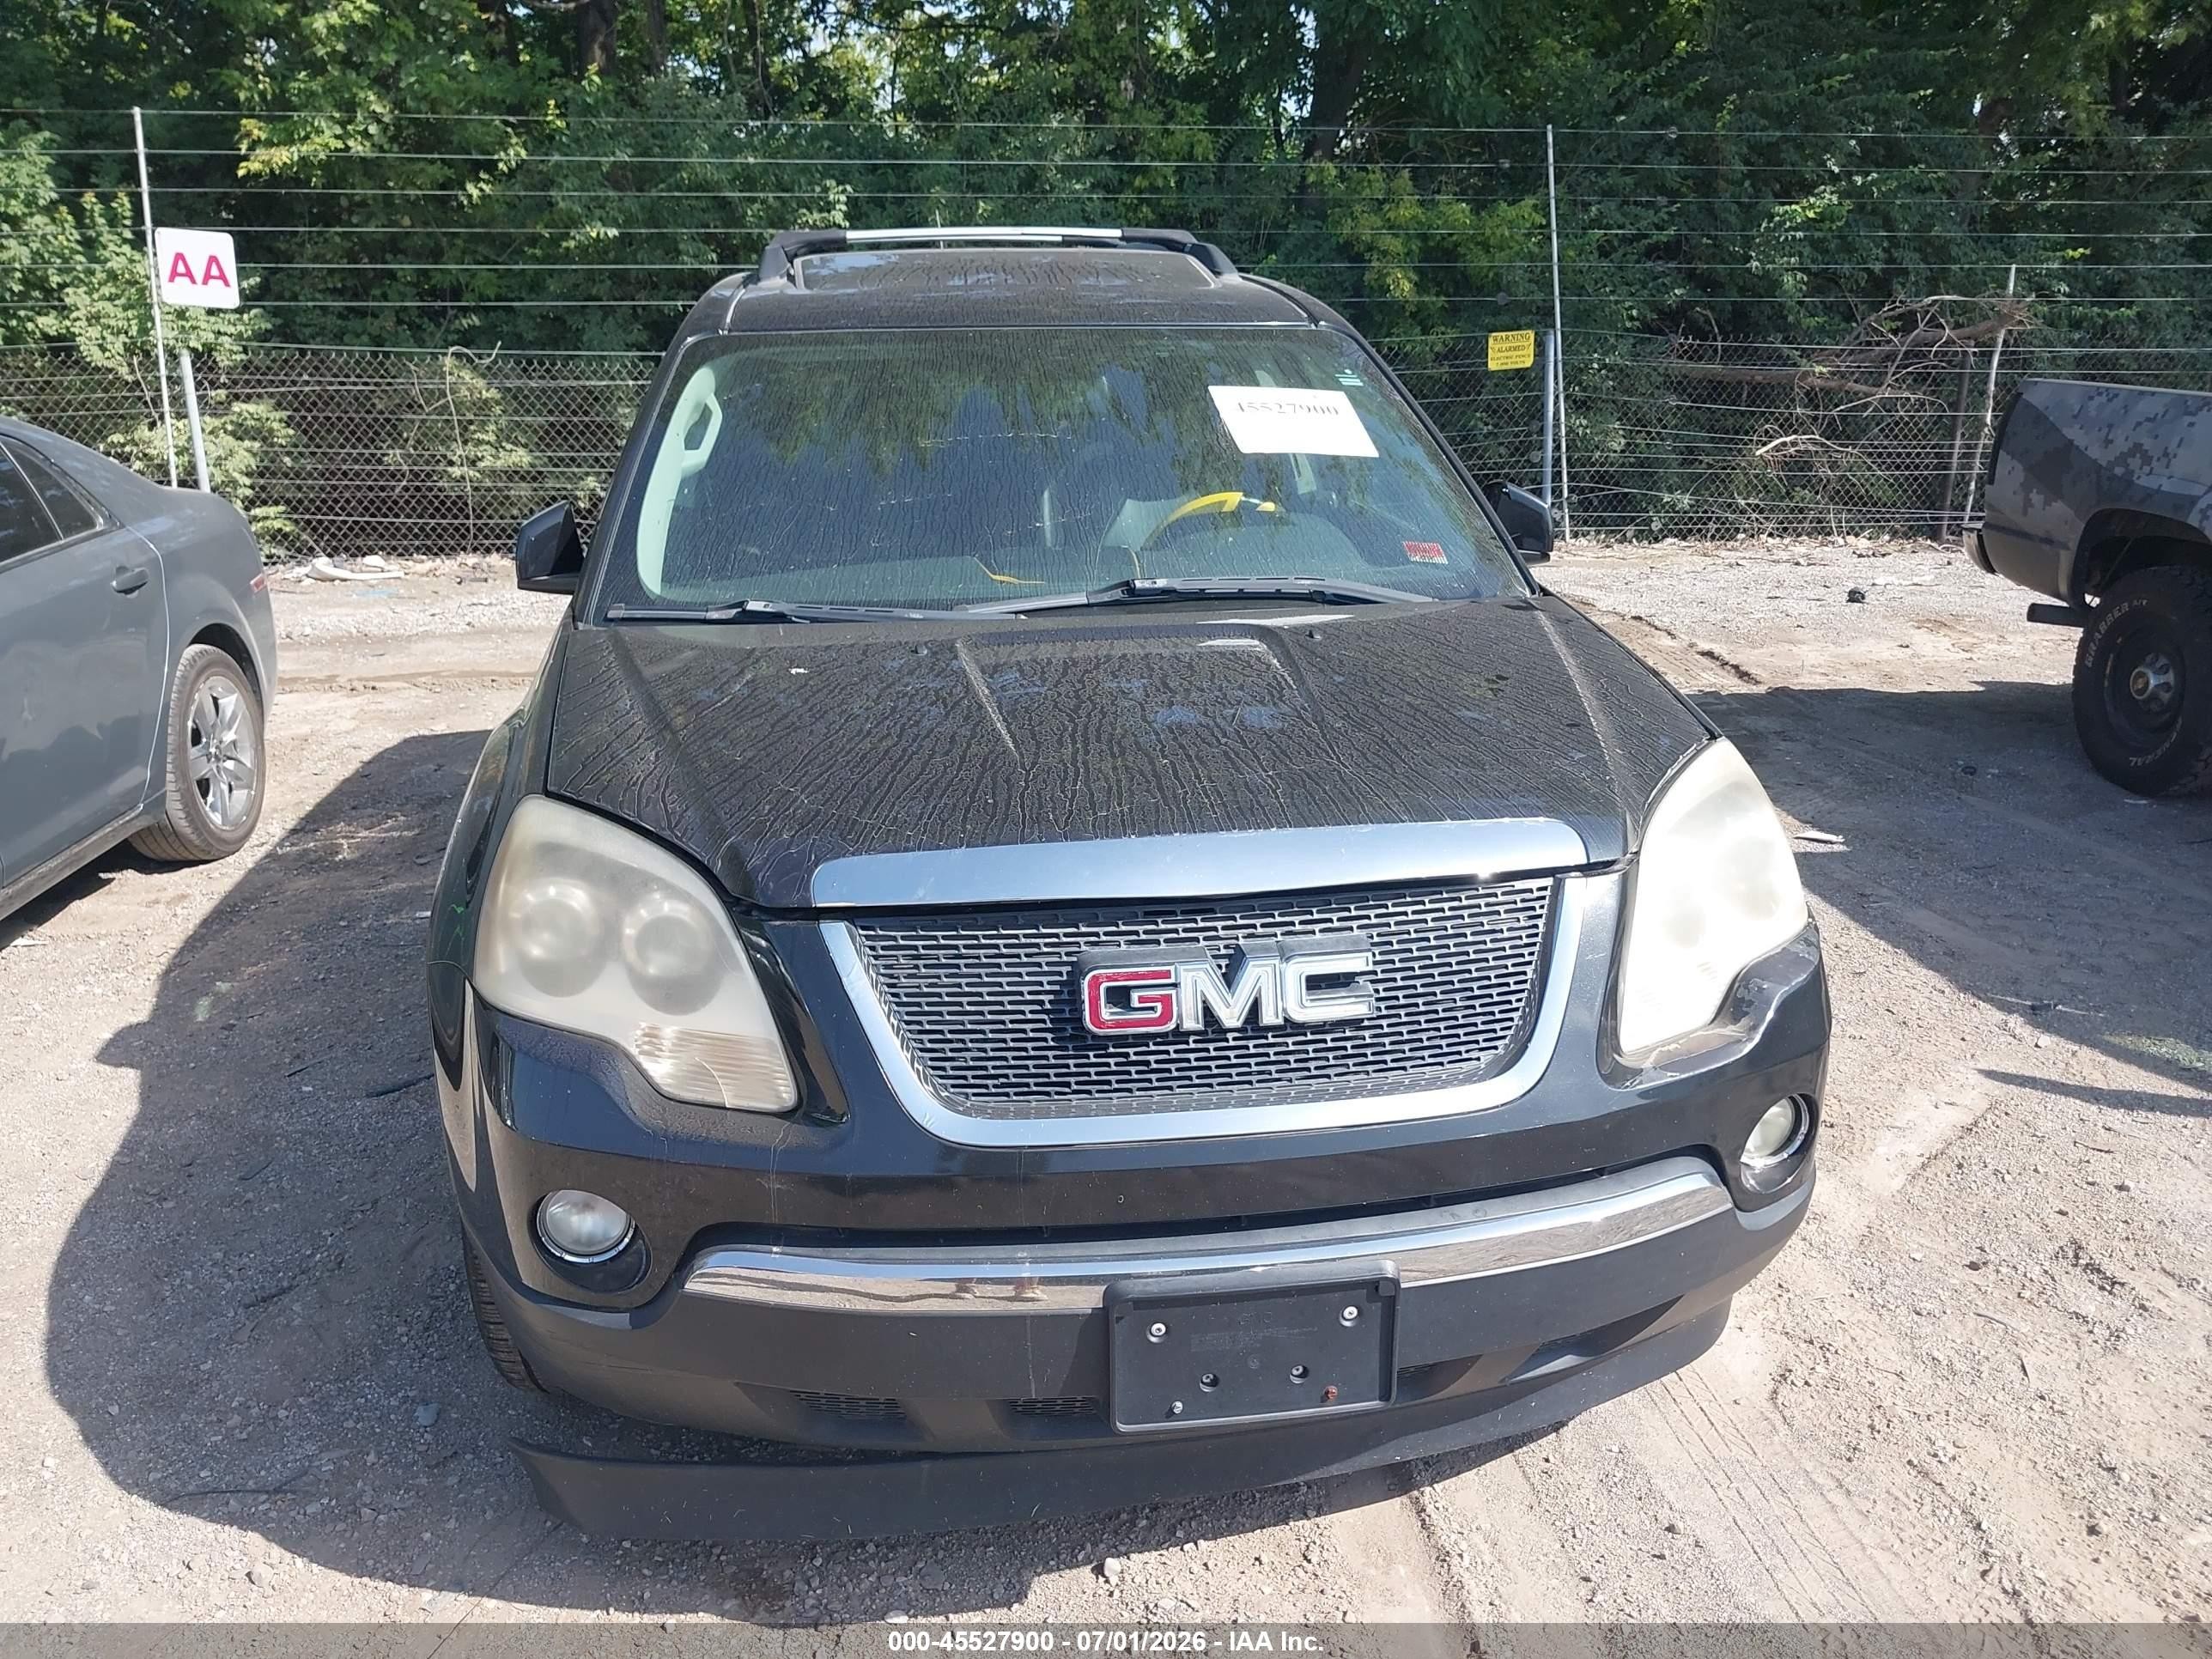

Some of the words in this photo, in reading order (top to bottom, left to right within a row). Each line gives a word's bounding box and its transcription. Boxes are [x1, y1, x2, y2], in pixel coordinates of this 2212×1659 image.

[167, 252, 231, 288] AA
[1492, 332, 1530, 343] WARNING
[1497, 344, 1526, 353] ALARMED
[1079, 936, 1376, 1036] GMC
